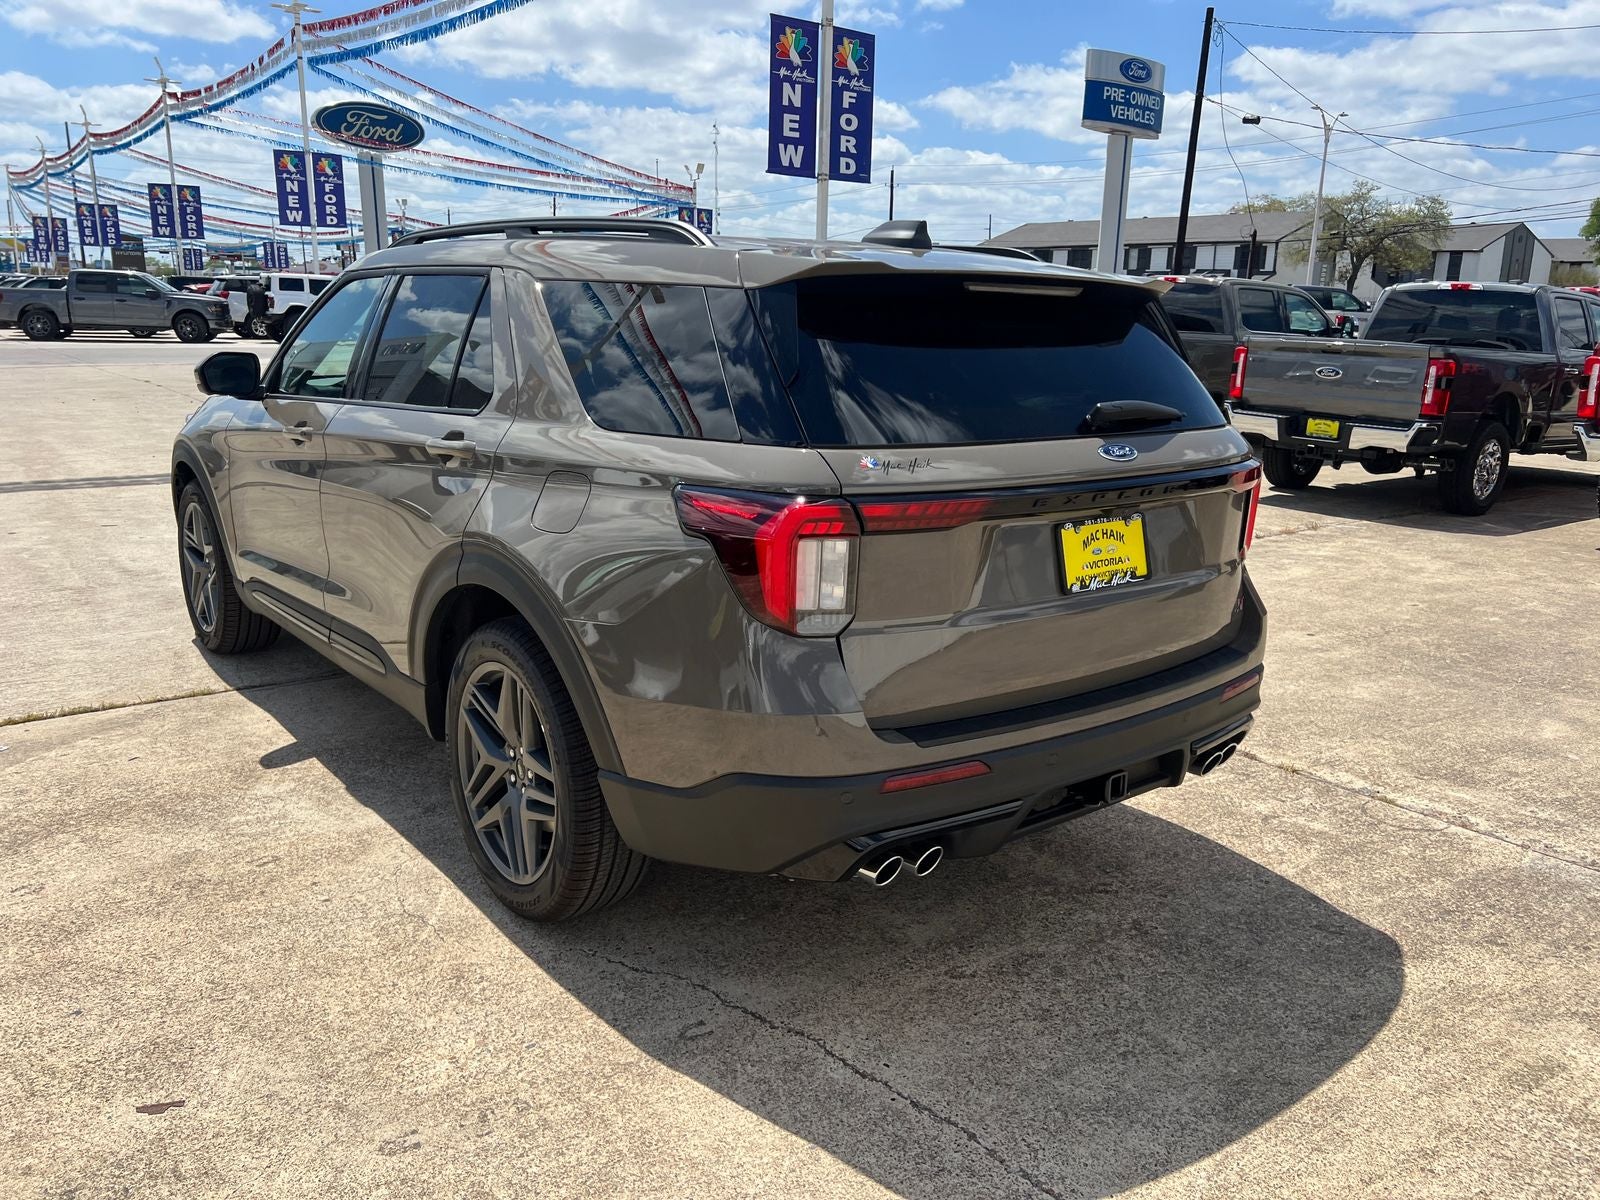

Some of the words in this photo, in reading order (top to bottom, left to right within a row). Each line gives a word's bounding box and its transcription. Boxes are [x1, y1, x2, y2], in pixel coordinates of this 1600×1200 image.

[1128, 61, 1147, 78] Ford
[340, 110, 403, 142] Ford
[779, 82, 804, 168] NEW
[1110, 104, 1155, 125] VEHICLES
[839, 91, 859, 175] FORD
[285, 180, 303, 222] NEW
[323, 183, 338, 225] FORD
[83, 219, 95, 244] NEW
[157, 204, 170, 236] NEW
[185, 206, 197, 237] FORD
[37, 230, 47, 250] NEW
[56, 230, 65, 251] FORD
[106, 220, 116, 245] FORD
[1109, 445, 1133, 457] Ford
[880, 459, 905, 476] Mac
[907, 458, 949, 474] Haik
[1082, 529, 1100, 551] MAC
[1102, 528, 1126, 545] HAIK
[1088, 556, 1124, 570] VICTORIA
[1110, 571, 1144, 587] Haik
